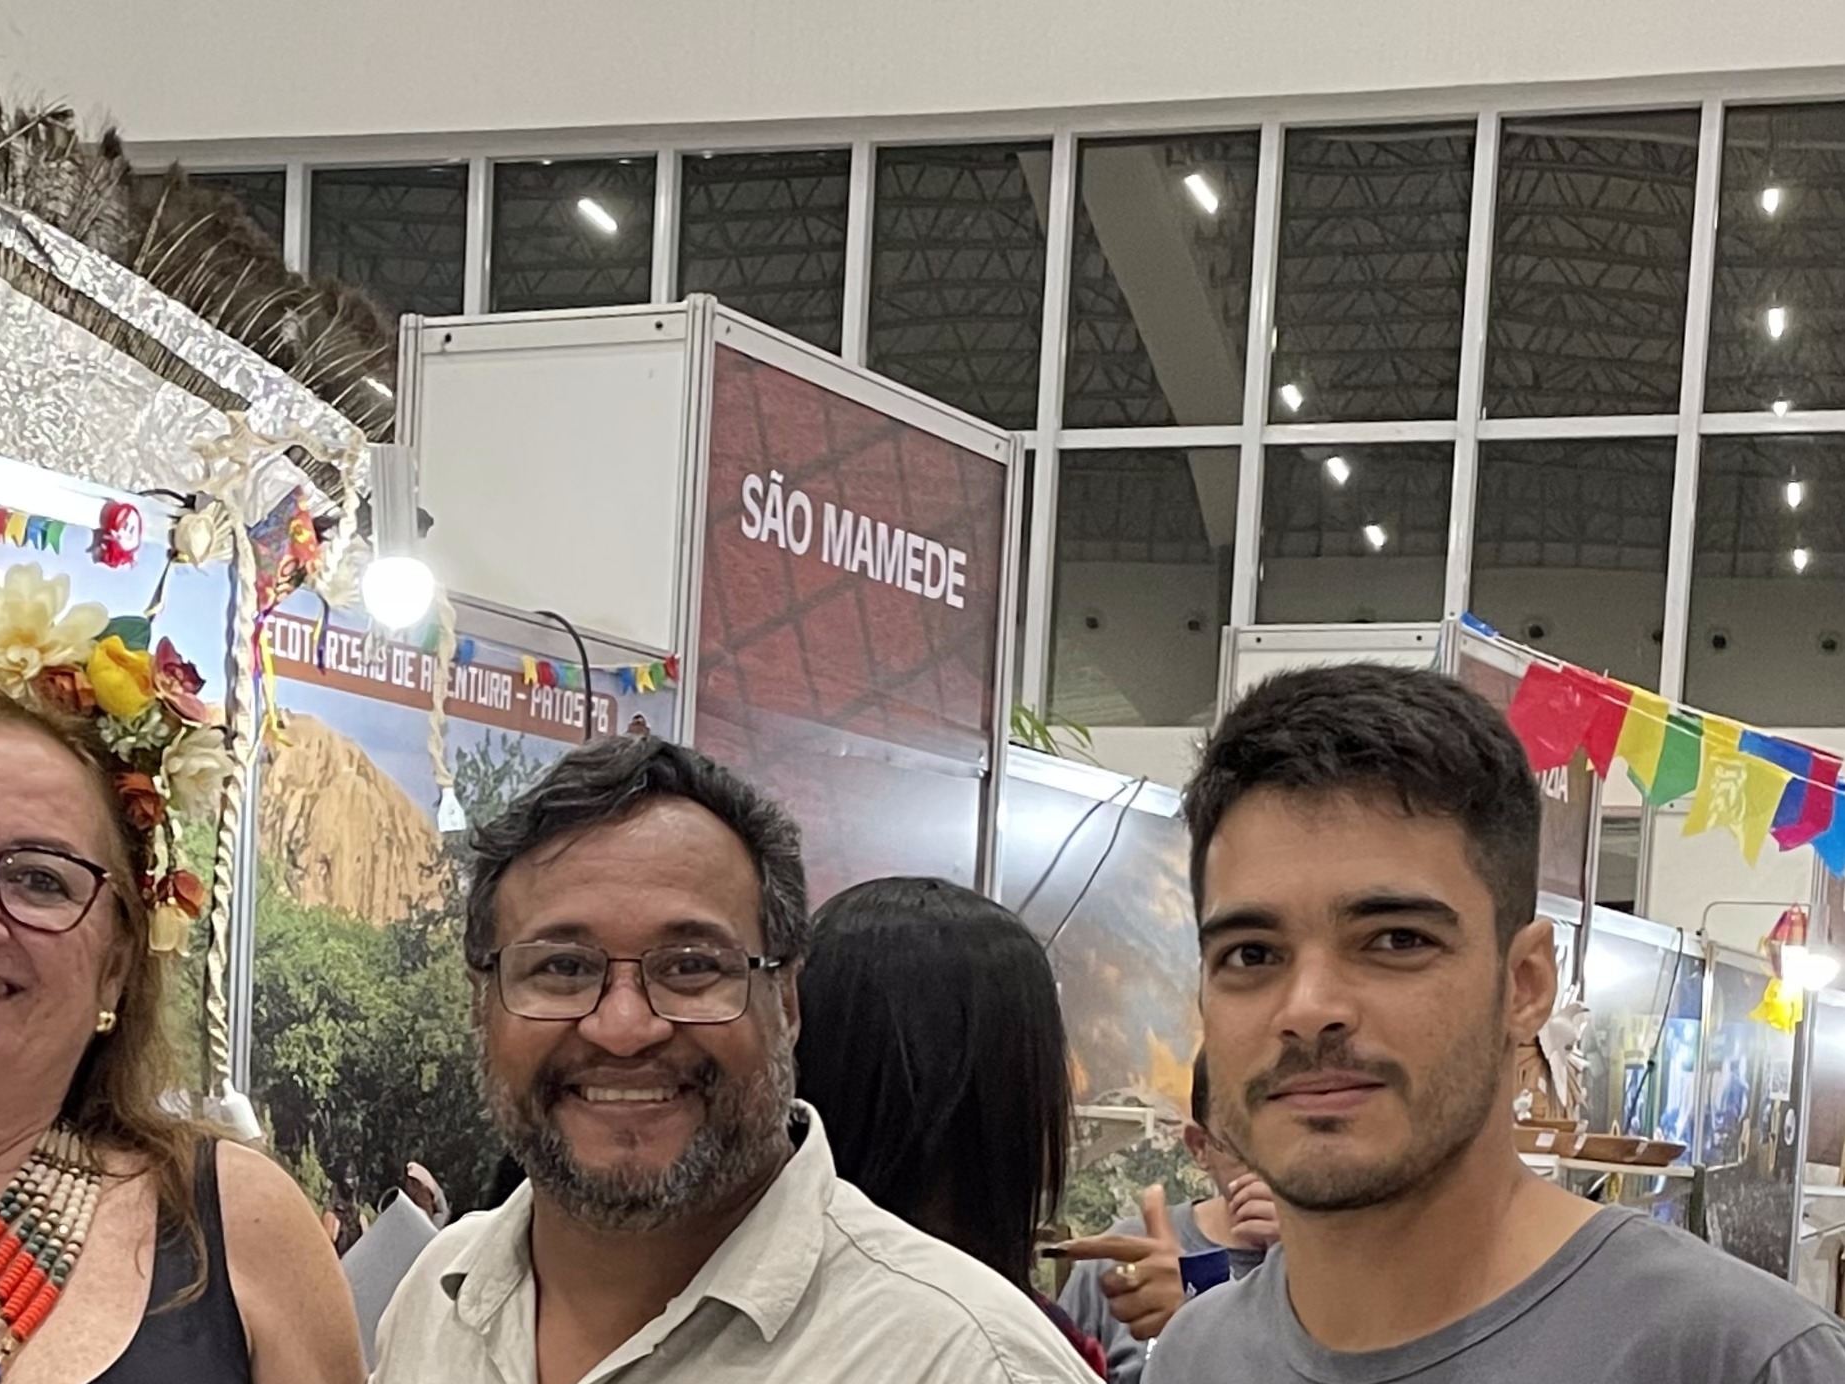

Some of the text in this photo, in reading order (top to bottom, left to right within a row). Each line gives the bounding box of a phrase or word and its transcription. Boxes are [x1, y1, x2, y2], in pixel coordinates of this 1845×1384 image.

[741, 469, 967, 609] SÃO MAMEDE
[391, 647, 416, 688] DE
[530, 682, 585, 728] PATOS
